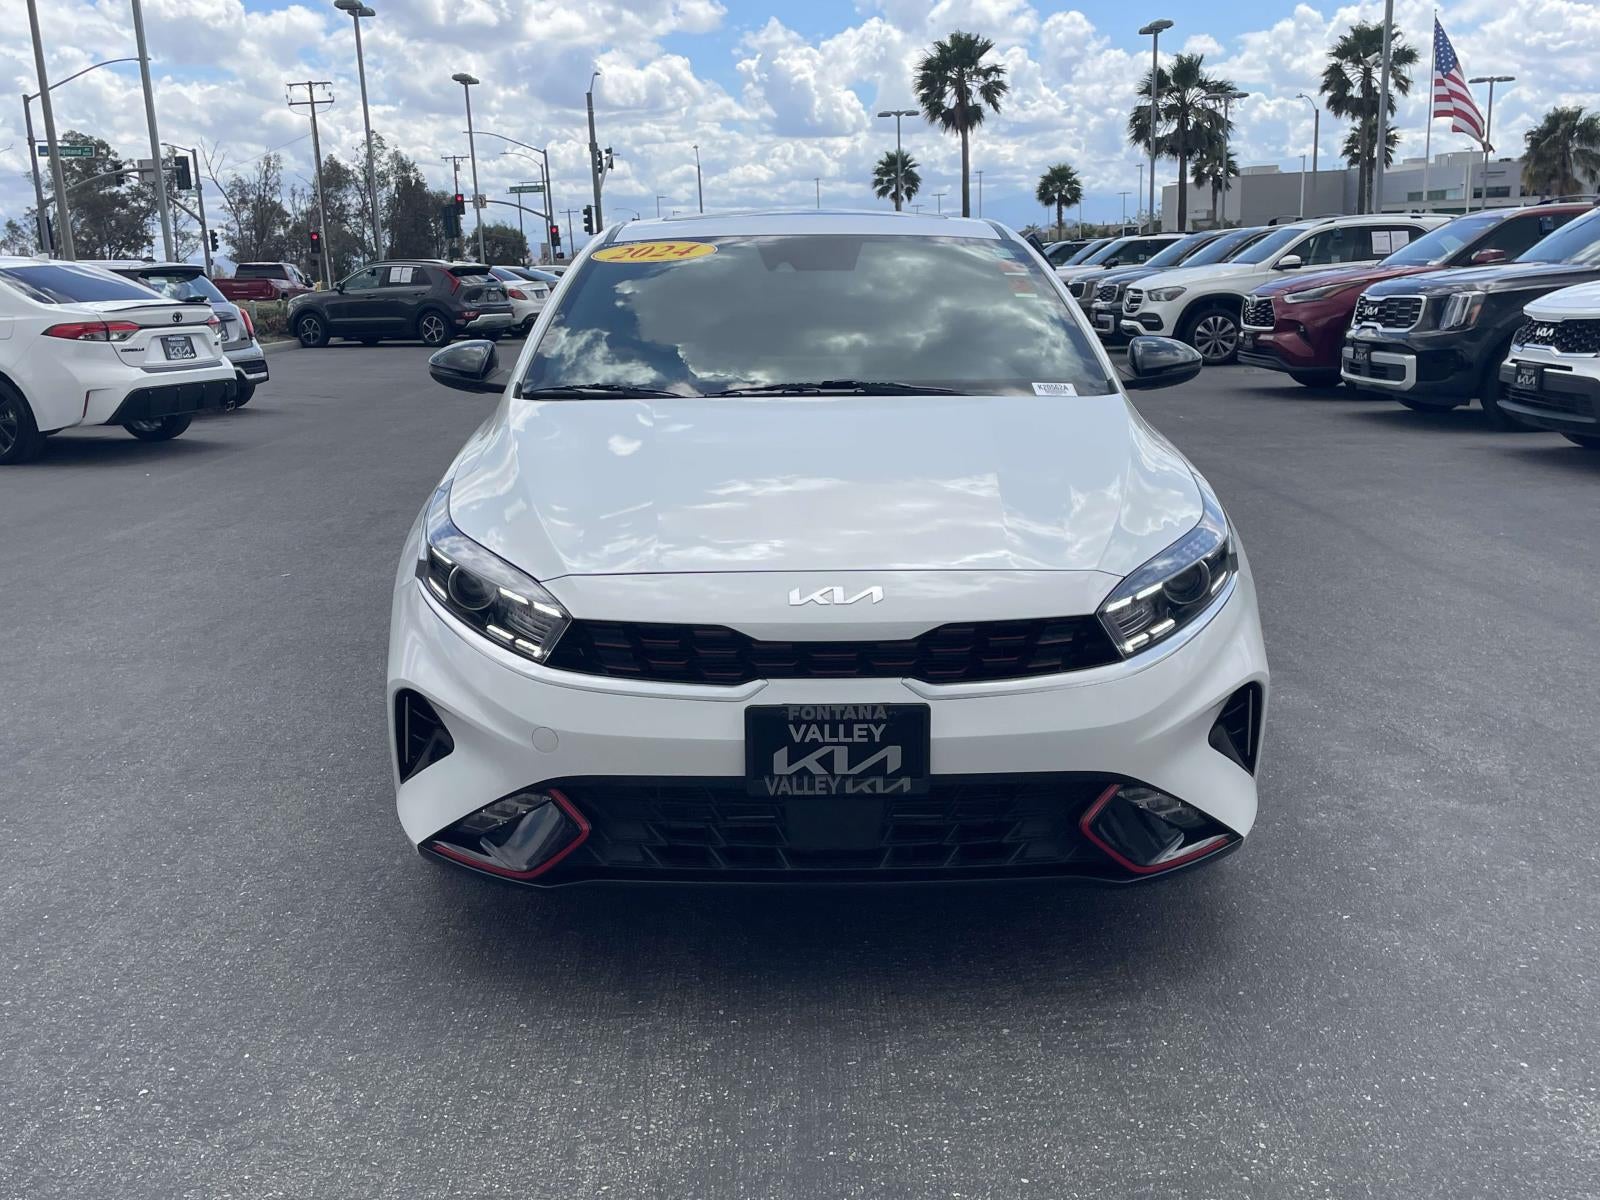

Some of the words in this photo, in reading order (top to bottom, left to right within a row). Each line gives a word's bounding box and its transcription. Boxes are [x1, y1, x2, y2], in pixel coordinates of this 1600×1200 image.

[58, 148, 81, 156] ighland
[608, 245, 699, 259] 2024
[1536, 327, 1554, 337] KIA
[789, 586, 884, 605] KIA
[788, 705, 887, 720] FONTANA
[788, 724, 886, 742] VALLEY
[773, 745, 902, 775] KIA
[764, 775, 843, 796] VALLEY
[845, 775, 912, 794] KIA
